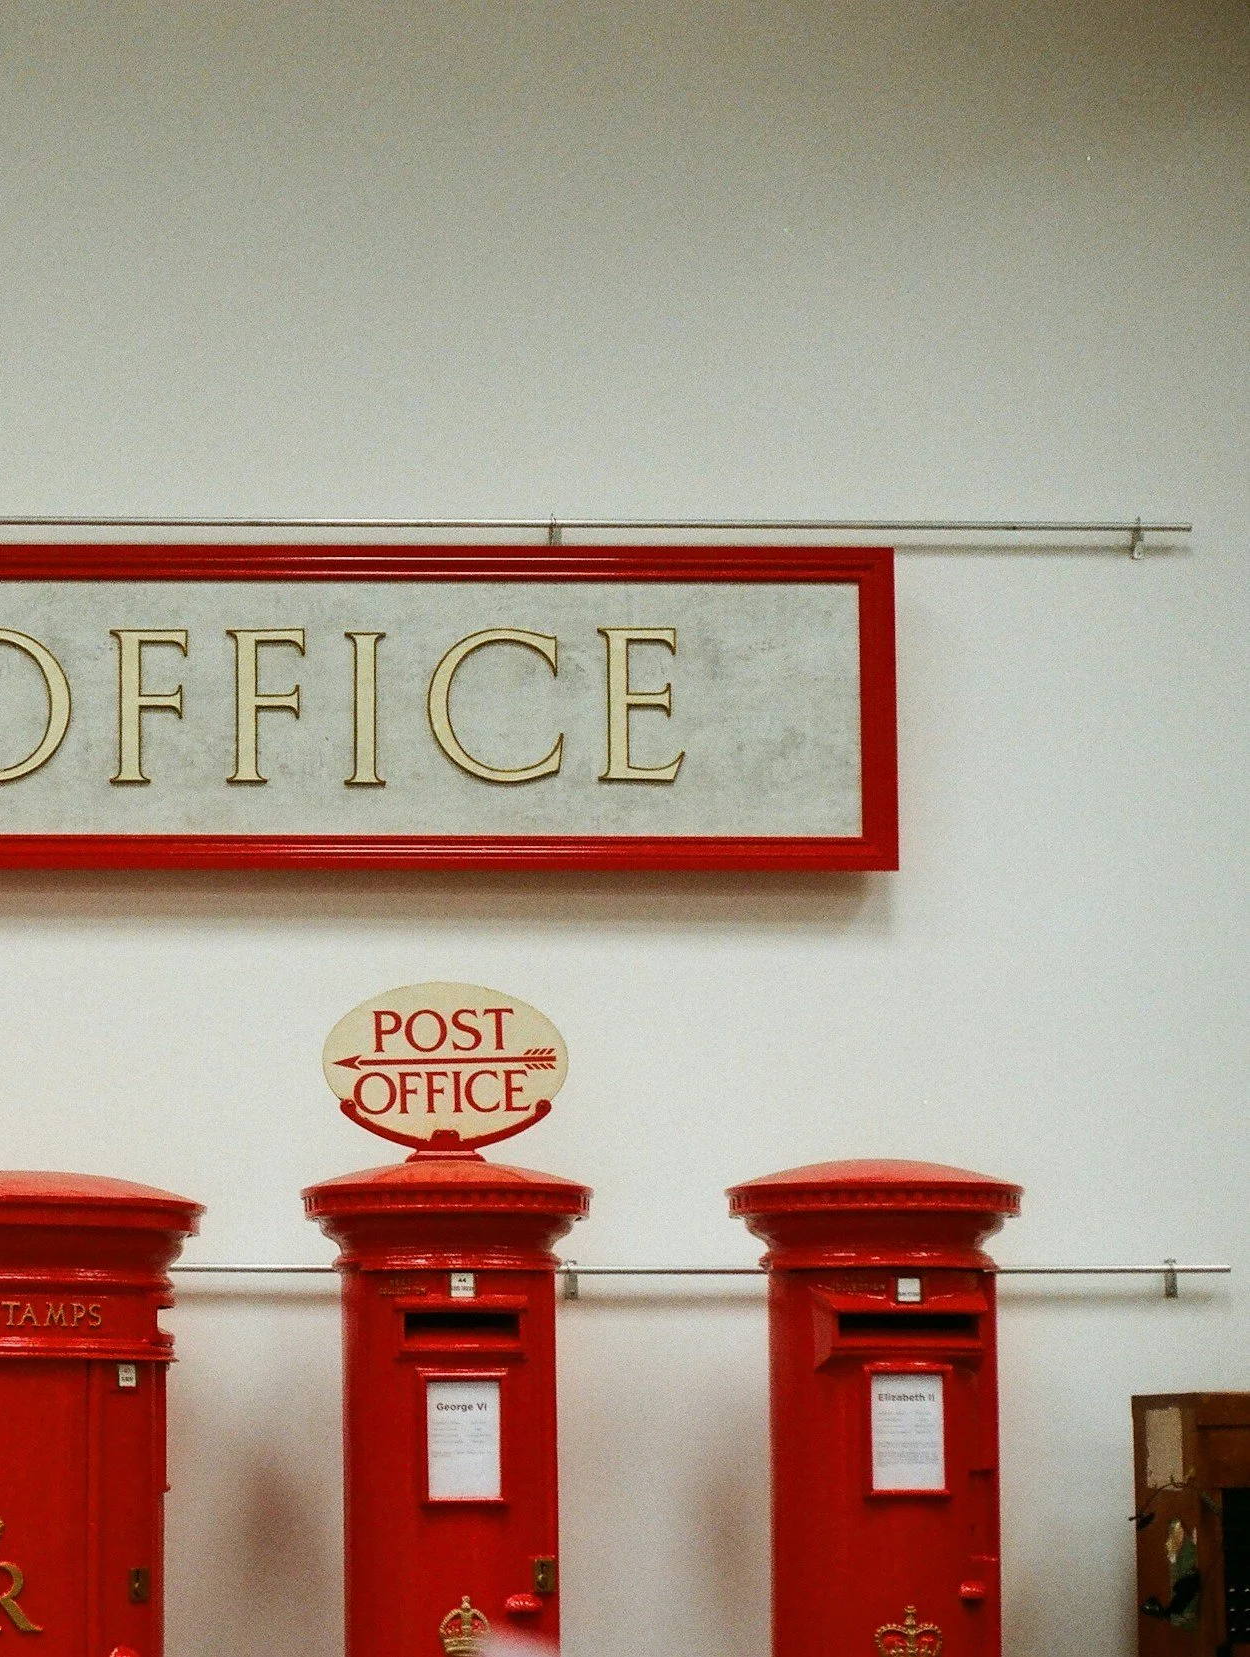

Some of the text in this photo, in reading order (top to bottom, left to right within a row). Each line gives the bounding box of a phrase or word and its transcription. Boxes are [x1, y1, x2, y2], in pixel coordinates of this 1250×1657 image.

[373, 1008, 514, 1053] POST
[353, 1069, 531, 1115] OFFICE
[436, 1402, 487, 1412] George VI
[878, 1393, 935, 1402] Elizabeth II
